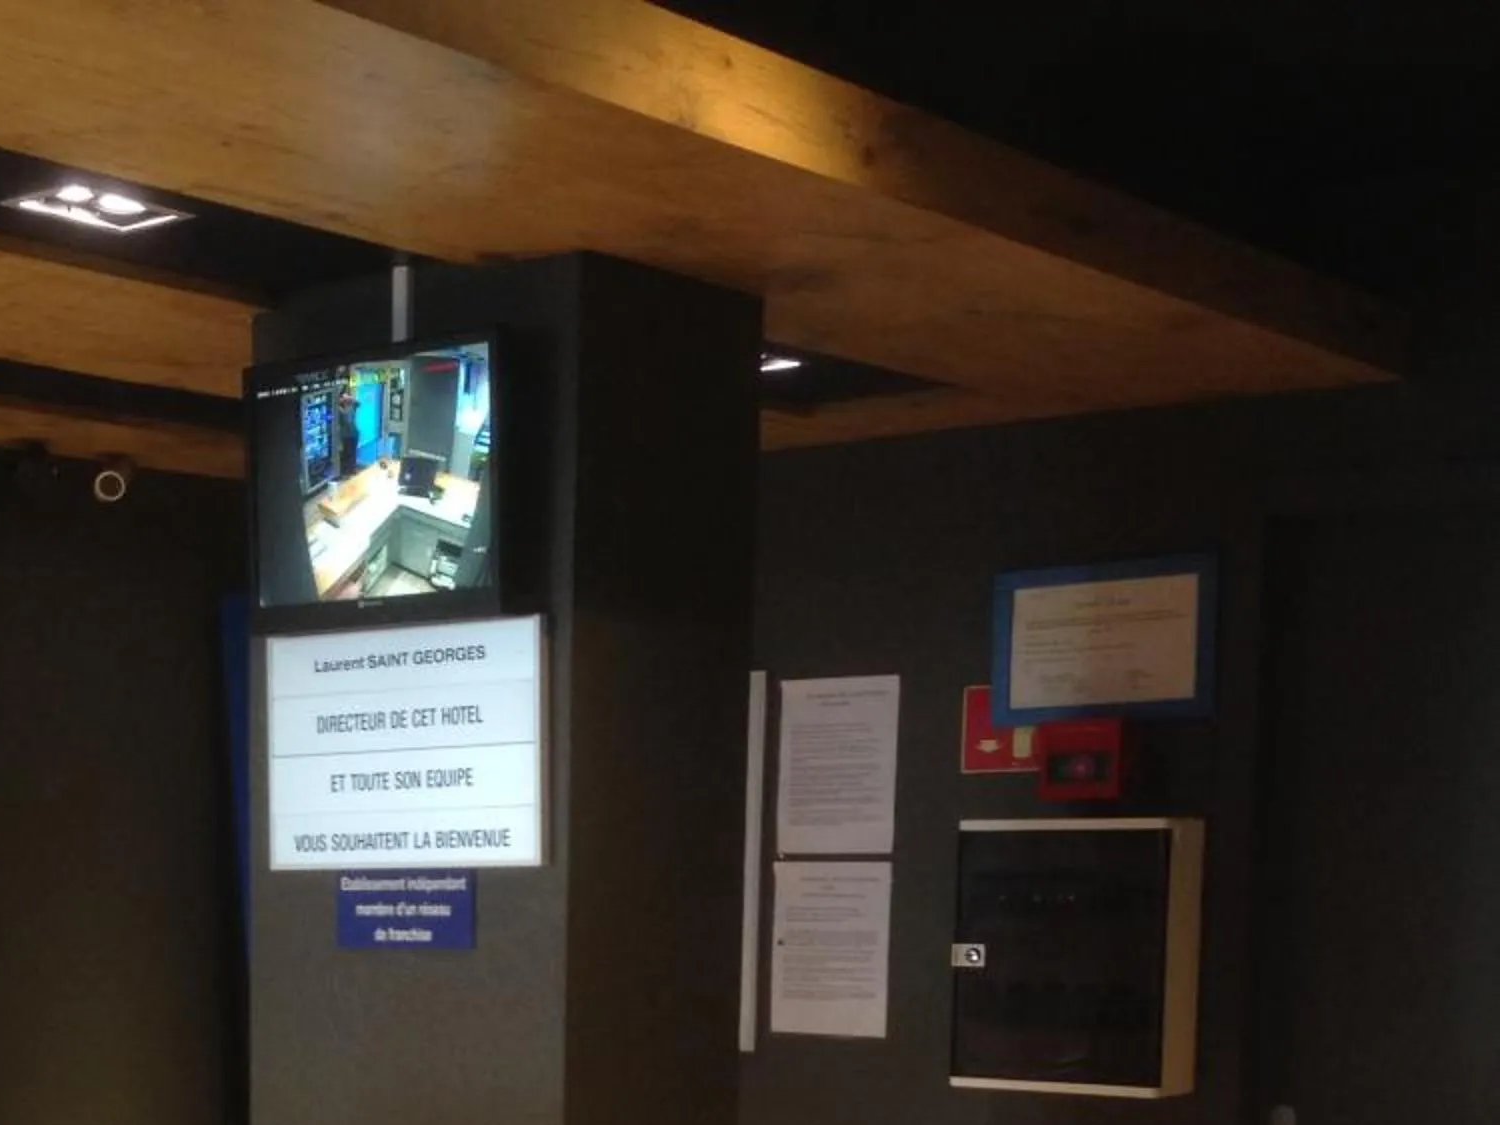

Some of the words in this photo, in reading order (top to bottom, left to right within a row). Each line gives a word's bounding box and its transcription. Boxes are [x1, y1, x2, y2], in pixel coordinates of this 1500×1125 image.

[314, 657, 364, 673] Laurent
[367, 651, 410, 669] SAINT
[412, 645, 486, 665] GEORGES
[316, 712, 386, 734] DIRECTEUR
[390, 709, 409, 729] DE
[411, 708, 436, 727] CET
[441, 704, 483, 725] HOTEL
[330, 773, 346, 793] ET
[350, 771, 390, 792] TOUTE
[394, 770, 422, 790] SON
[426, 767, 474, 788] EQUIPE
[294, 833, 328, 853] VOUS
[330, 830, 410, 852] SOUHAITENT
[412, 829, 431, 850] LA
[434, 828, 512, 849] BIENVENUE
